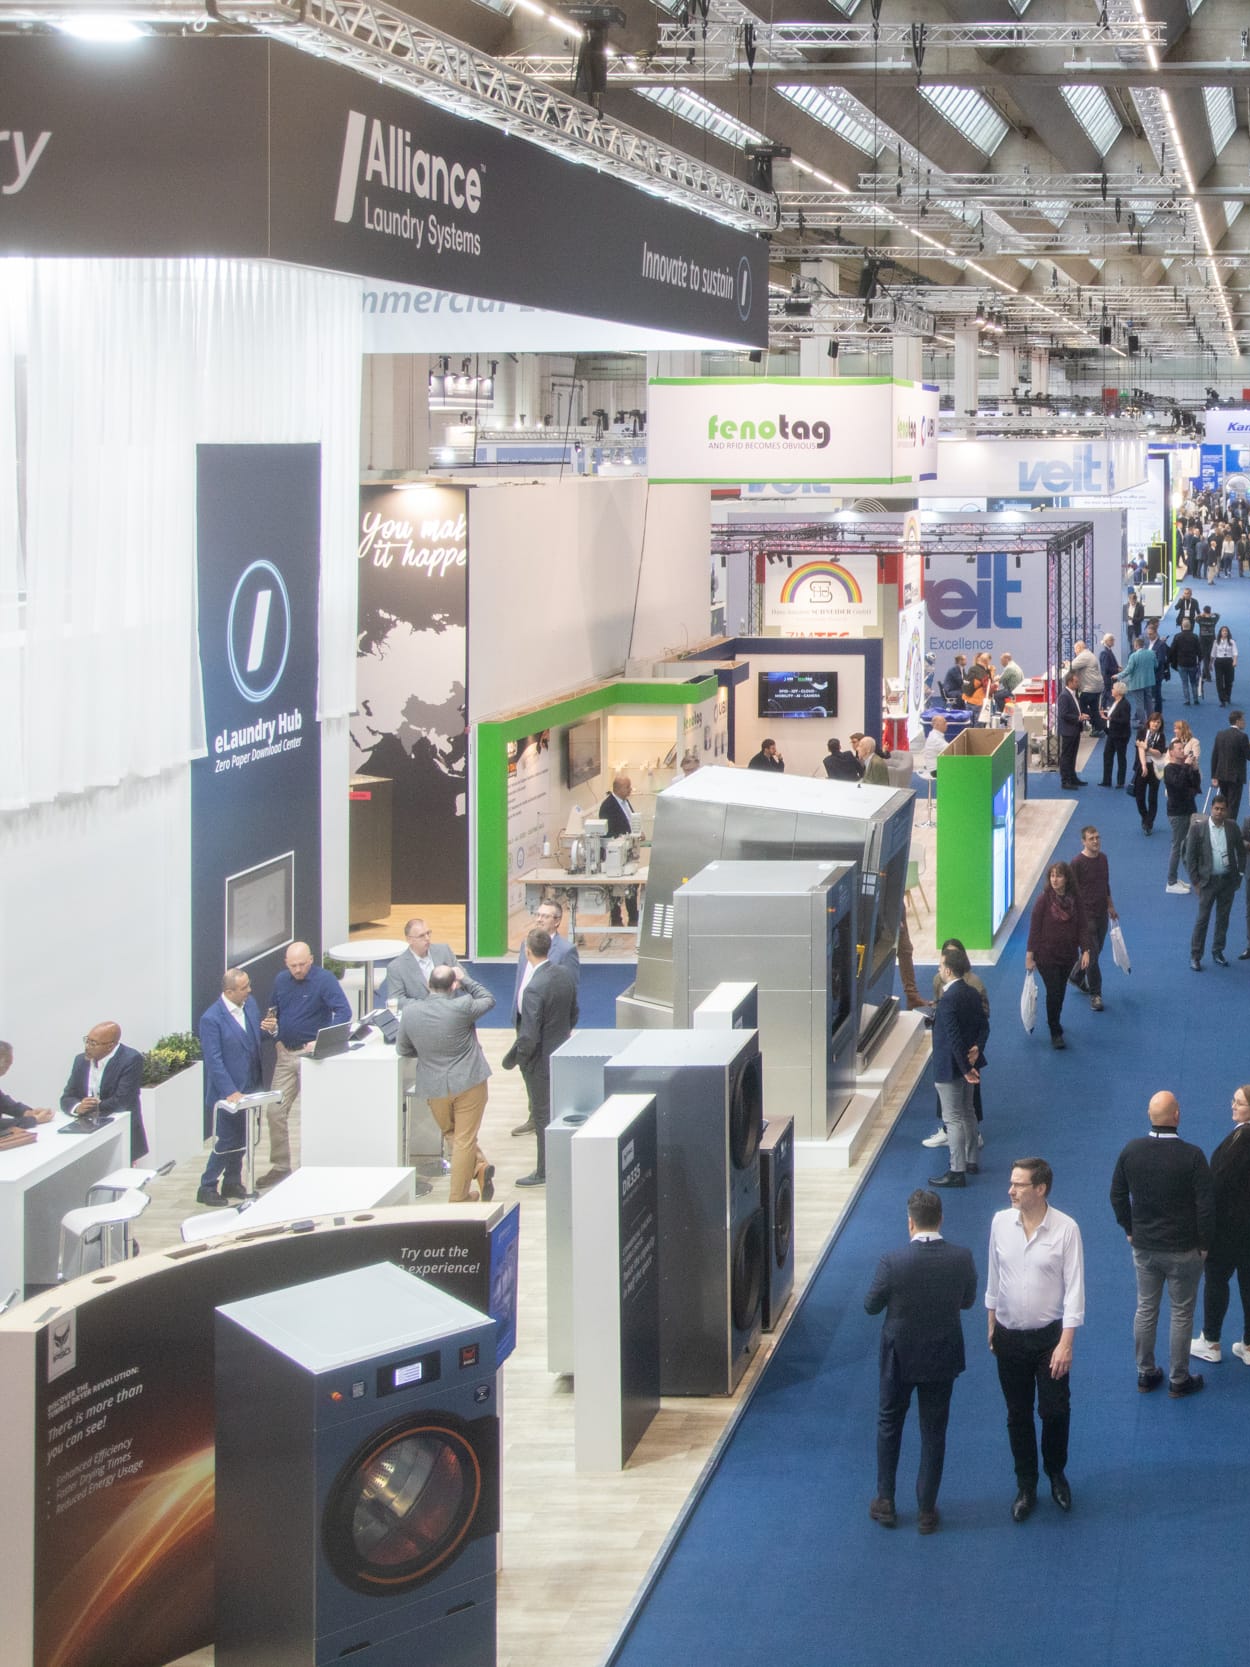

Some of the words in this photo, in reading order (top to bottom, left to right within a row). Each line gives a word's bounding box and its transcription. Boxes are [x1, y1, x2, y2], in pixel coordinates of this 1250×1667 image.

[0, 131, 52, 195] y
[365, 119, 481, 213] Alliance
[365, 196, 424, 249] Laundry
[428, 214, 481, 256] Systems
[642, 241, 688, 288] Innovate
[690, 259, 700, 291] to
[702, 266, 734, 300] sustain
[708, 414, 831, 449] fenotag
[708, 442, 725, 450] AND
[726, 442, 744, 450] RFID
[745, 442, 781, 450] BECOMES
[782, 442, 816, 450] OBVIOUS
[1018, 443, 1102, 492] veit
[357, 511, 413, 558] You
[373, 539, 408, 568] it
[924, 552, 1022, 630] eit
[929, 636, 994, 650] Excellence
[215, 718, 275, 754] eLaundry
[278, 708, 302, 735] Hub
[214, 759, 231, 773] Zero
[231, 752, 251, 769] Paper
[251, 740, 282, 761] Download
[283, 736, 302, 751] Center
[401, 1247, 421, 1262] Try
[424, 1248, 444, 1258] out
[448, 1245, 469, 1258] the
[408, 1262, 481, 1276] experience!
[77, 1382, 89, 1394] THE
[93, 1366, 139, 1392] REVOLUTION:
[48, 1418, 73, 1442] There
[75, 1411, 84, 1424] is
[86, 1397, 114, 1420] more
[117, 1383, 144, 1404] than
[47, 1444, 63, 1465] you
[65, 1430, 83, 1449] can
[85, 1415, 107, 1437] see!
[94, 1438, 134, 1465] Efficiency
[89, 1473, 116, 1494] Energy
[117, 1459, 144, 1478] Usage
[107, 1451, 132, 1469] Times
